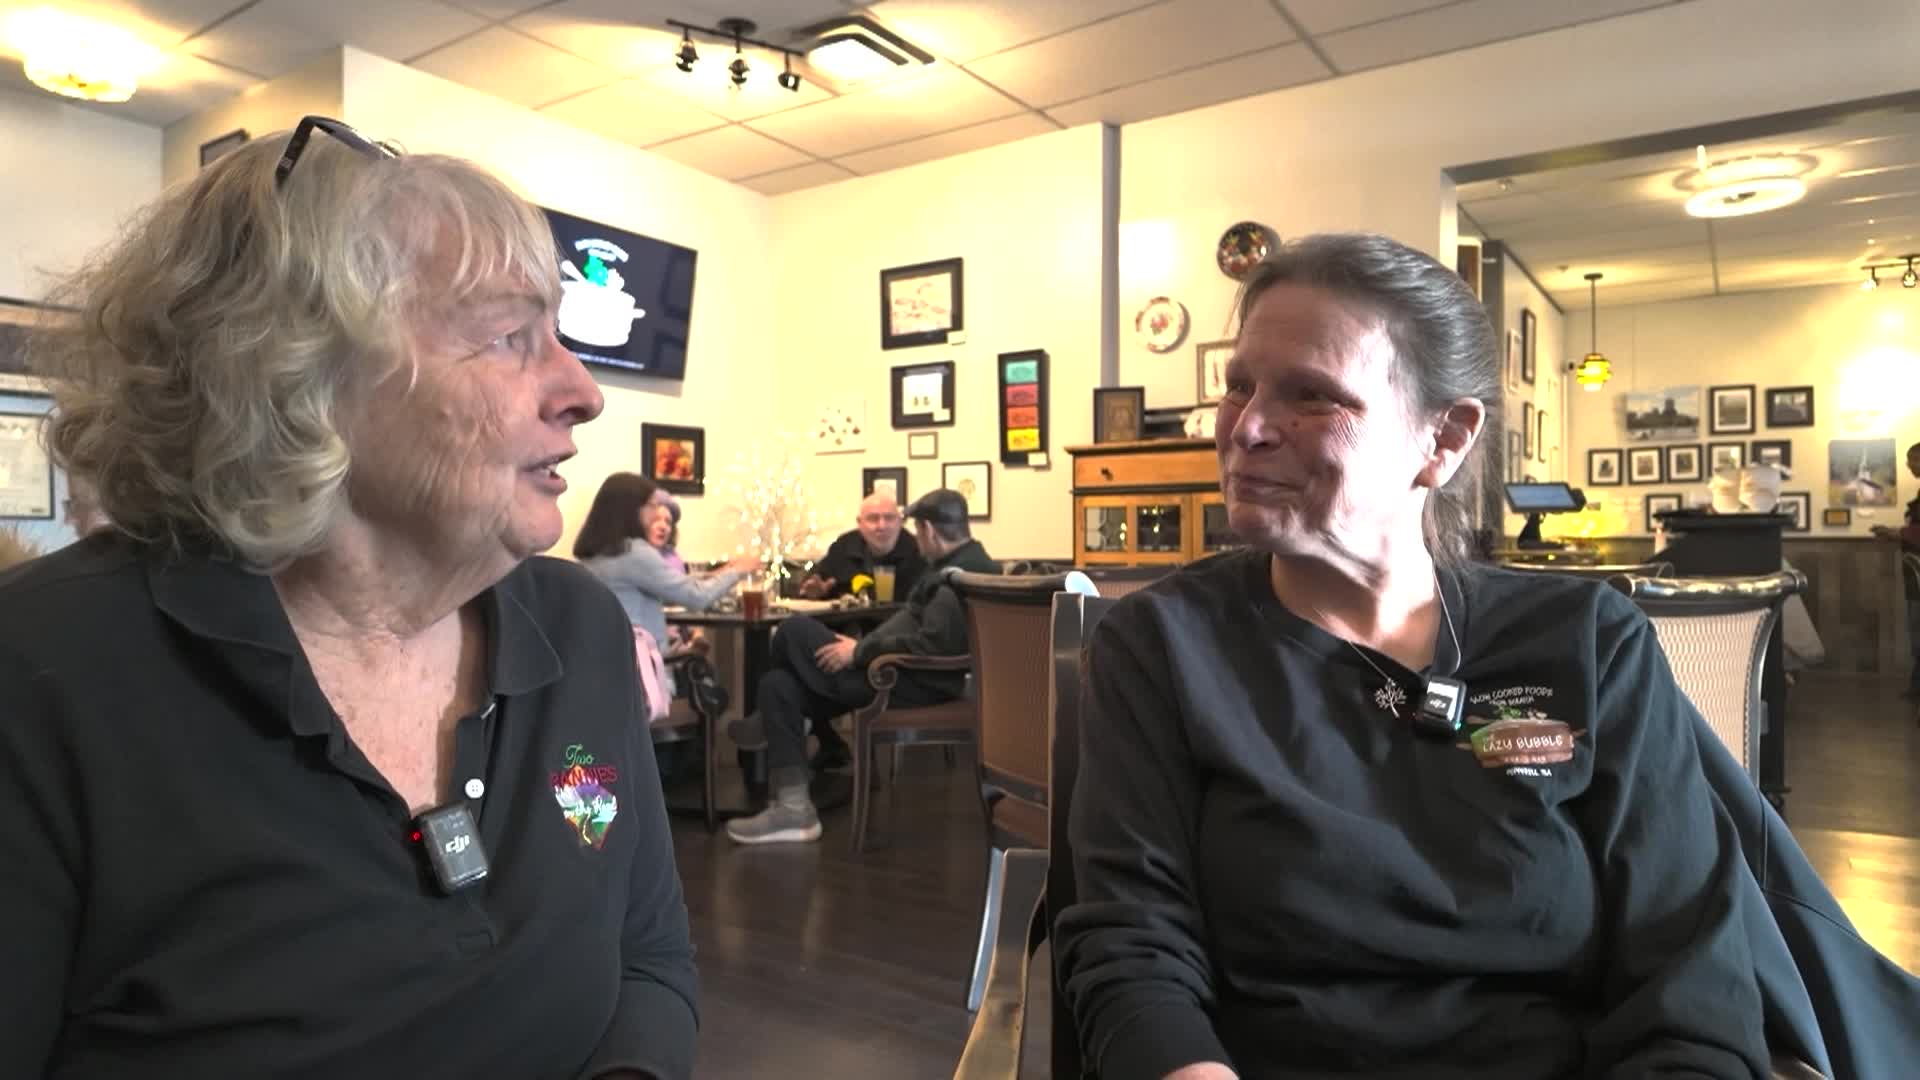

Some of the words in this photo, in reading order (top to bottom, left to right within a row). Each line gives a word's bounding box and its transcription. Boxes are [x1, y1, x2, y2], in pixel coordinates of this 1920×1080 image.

[1482, 737, 1513, 753] LAZY
[1516, 735, 1564, 750] BUBBLE
[563, 743, 595, 769] Two
[445, 834, 470, 854] dji
